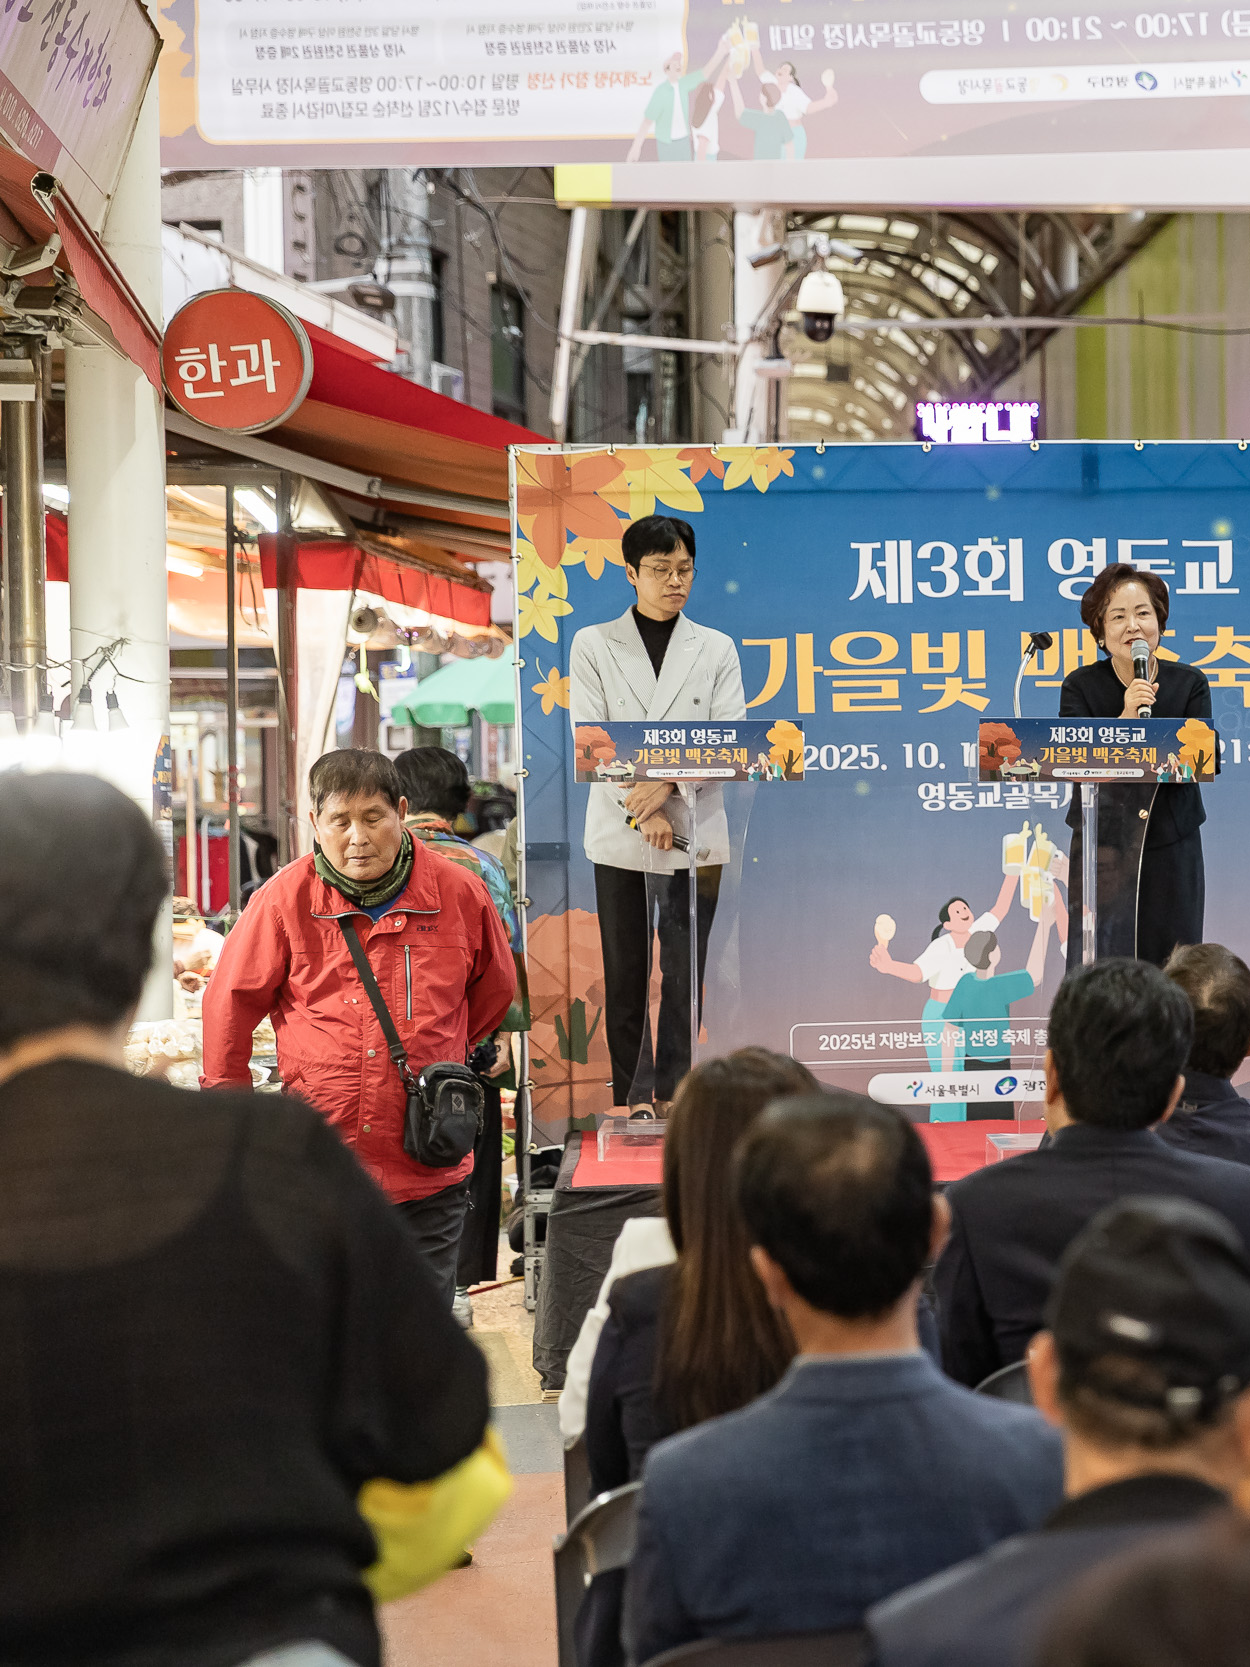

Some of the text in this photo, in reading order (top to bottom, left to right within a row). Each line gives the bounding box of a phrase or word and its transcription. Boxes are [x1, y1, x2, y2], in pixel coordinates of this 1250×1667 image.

[174, 338, 281, 400] 한과
[848, 537, 1024, 604] 제3회
[741, 629, 991, 714] 가을빛
[642, 728, 738, 746] 제3회 영동교
[1048, 726, 1147, 744] 제3회 영동교
[634, 747, 748, 765] 가을빛 맥주축제
[803, 743, 888, 771] 2025.
[902, 741, 946, 770] 10.
[1039, 746, 1157, 764] 가을빛 맥주축제
[818, 1032, 876, 1052] 2025년
[878, 1029, 966, 1051] 지방보조사업
[968, 1028, 999, 1048] 선정
[1001, 1027, 1031, 1047] 축제
[925, 1083, 980, 1097] 서울특별시
